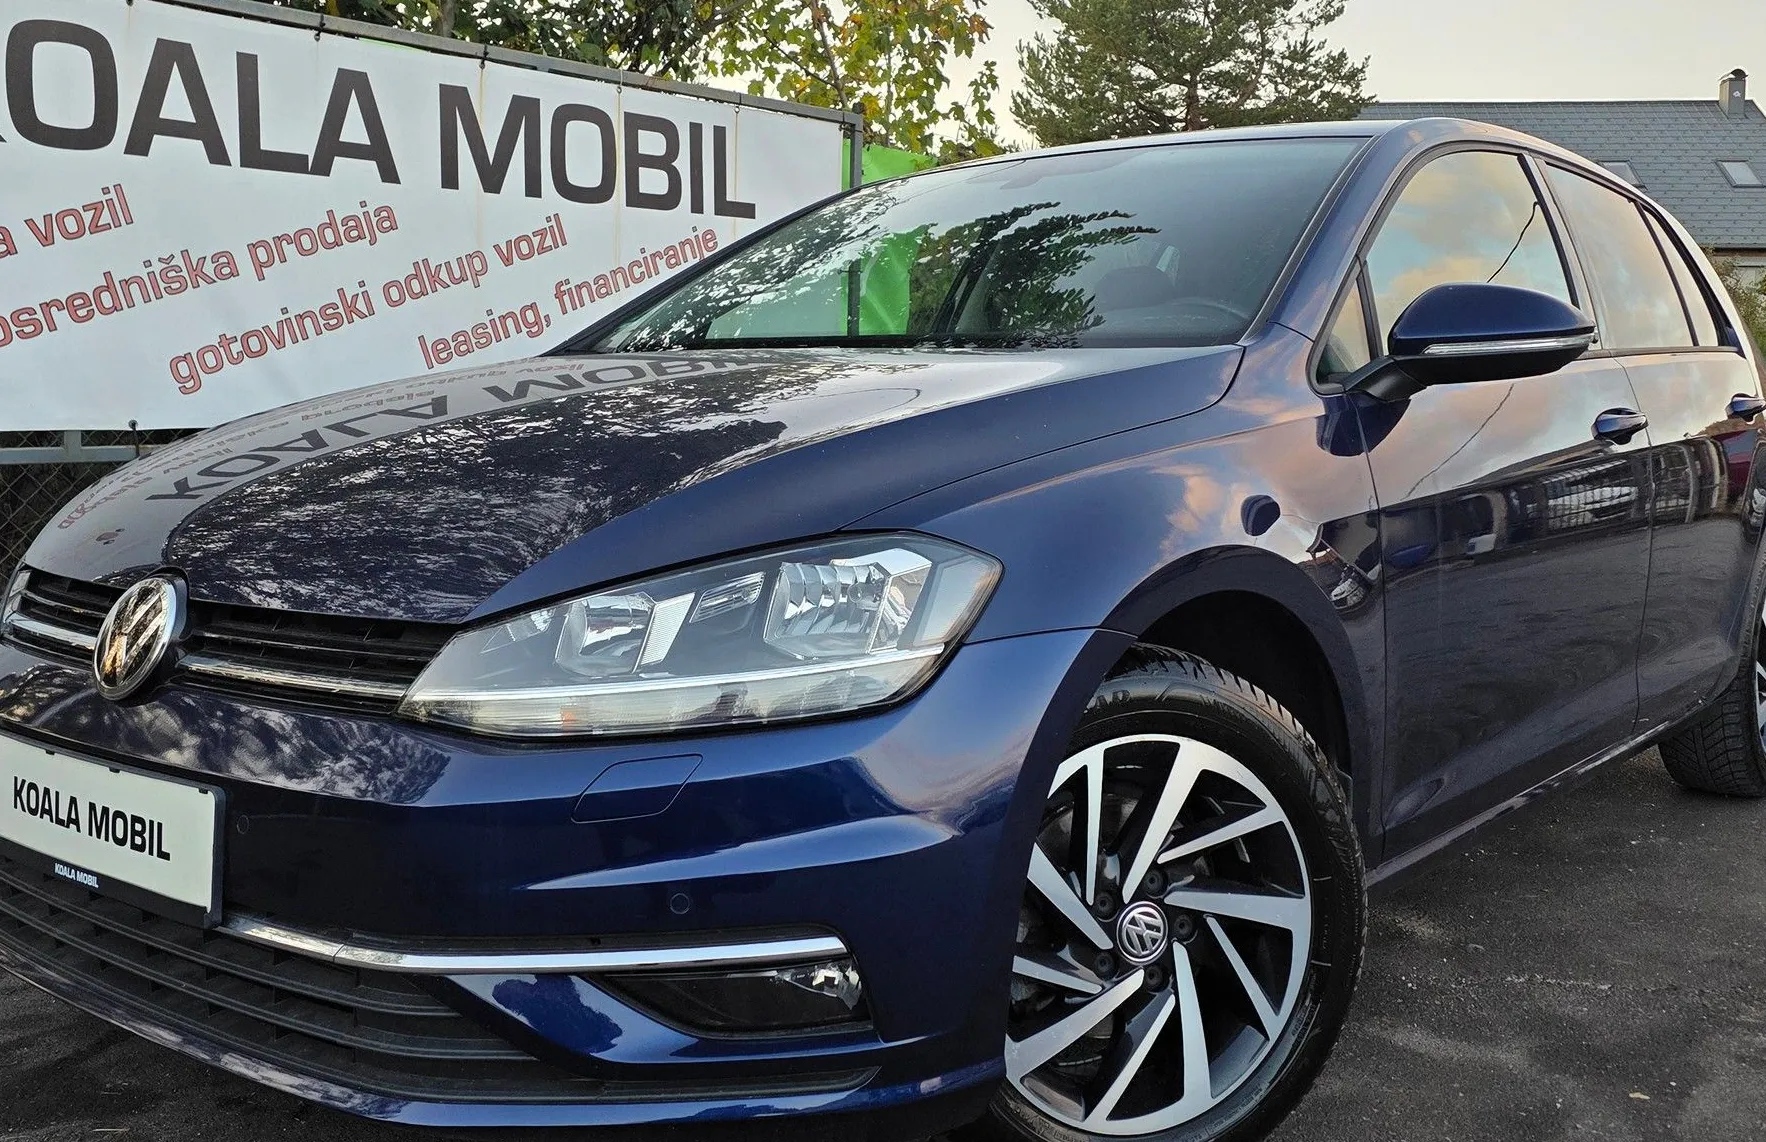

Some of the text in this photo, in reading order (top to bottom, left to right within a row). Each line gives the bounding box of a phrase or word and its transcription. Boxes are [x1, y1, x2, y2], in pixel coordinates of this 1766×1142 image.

[0, 19, 756, 219] OALA MOBIL
[24, 183, 133, 247] vozil
[247, 201, 398, 281] prodaja
[169, 213, 568, 395] gotovinski odkup vozil
[418, 226, 719, 370] leasing, financiranje
[13, 776, 171, 862] KOALA MOBIL
[55, 862, 99, 889] KOALA MOBIL
